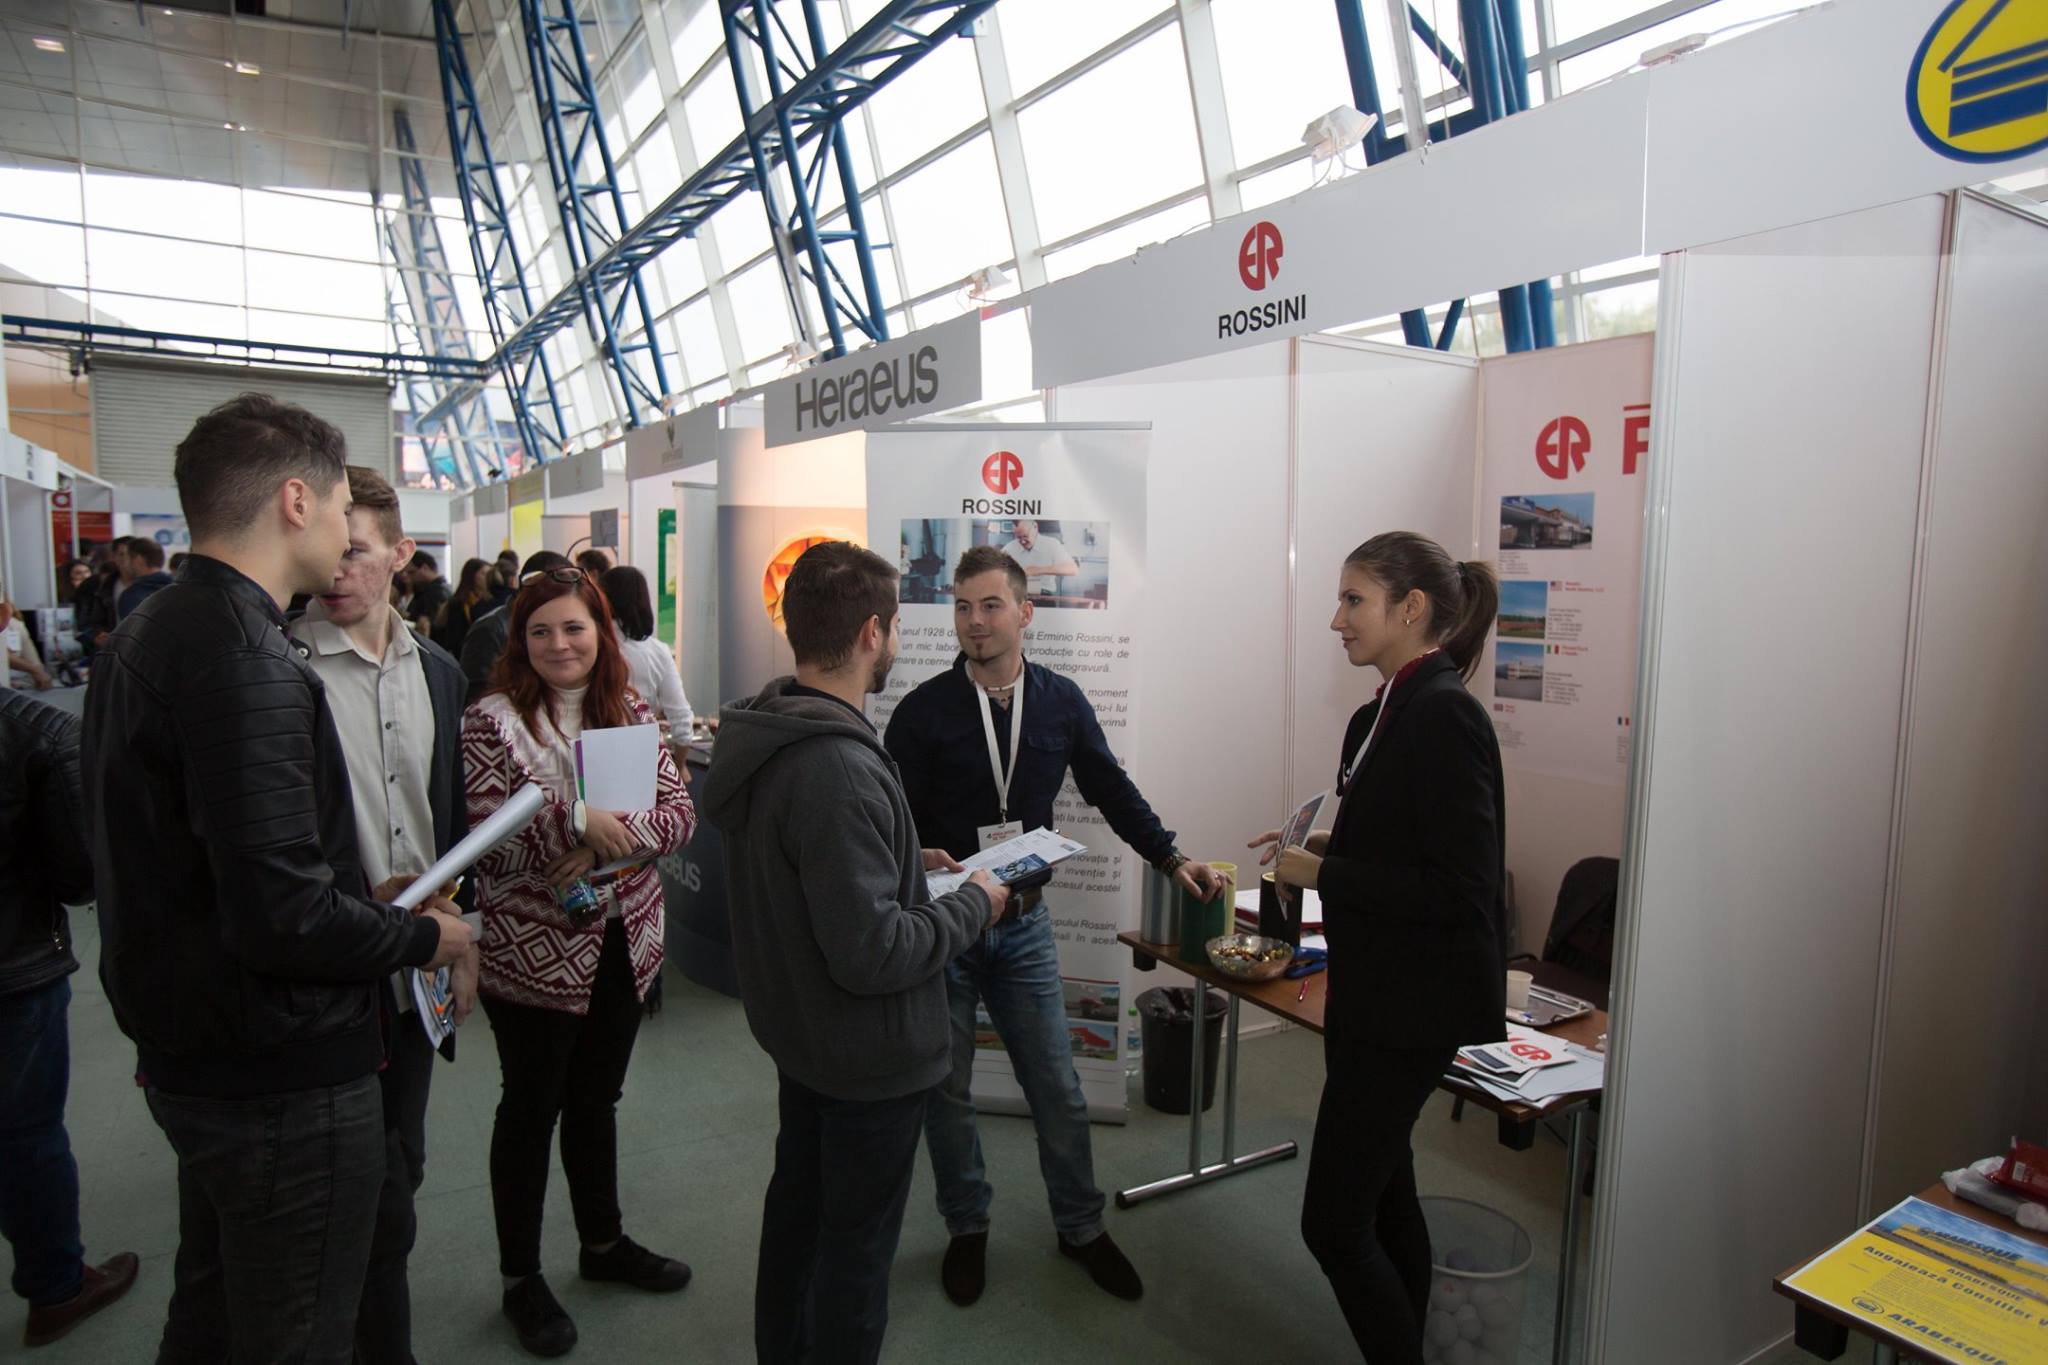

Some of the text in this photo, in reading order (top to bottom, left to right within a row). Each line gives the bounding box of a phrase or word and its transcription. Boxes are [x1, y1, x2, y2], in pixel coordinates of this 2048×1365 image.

[1219, 294, 1306, 339] ROSSINI
[795, 345, 938, 432] Heraeus
[962, 498, 1042, 516] ROSSINI
[923, 627, 945, 637] 1928
[1036, 631, 1073, 642] Erminio
[902, 643, 913, 651] un
[916, 643, 932, 651] mic
[1116, 650, 1130, 659] de
[1088, 688, 1128, 698] moment
